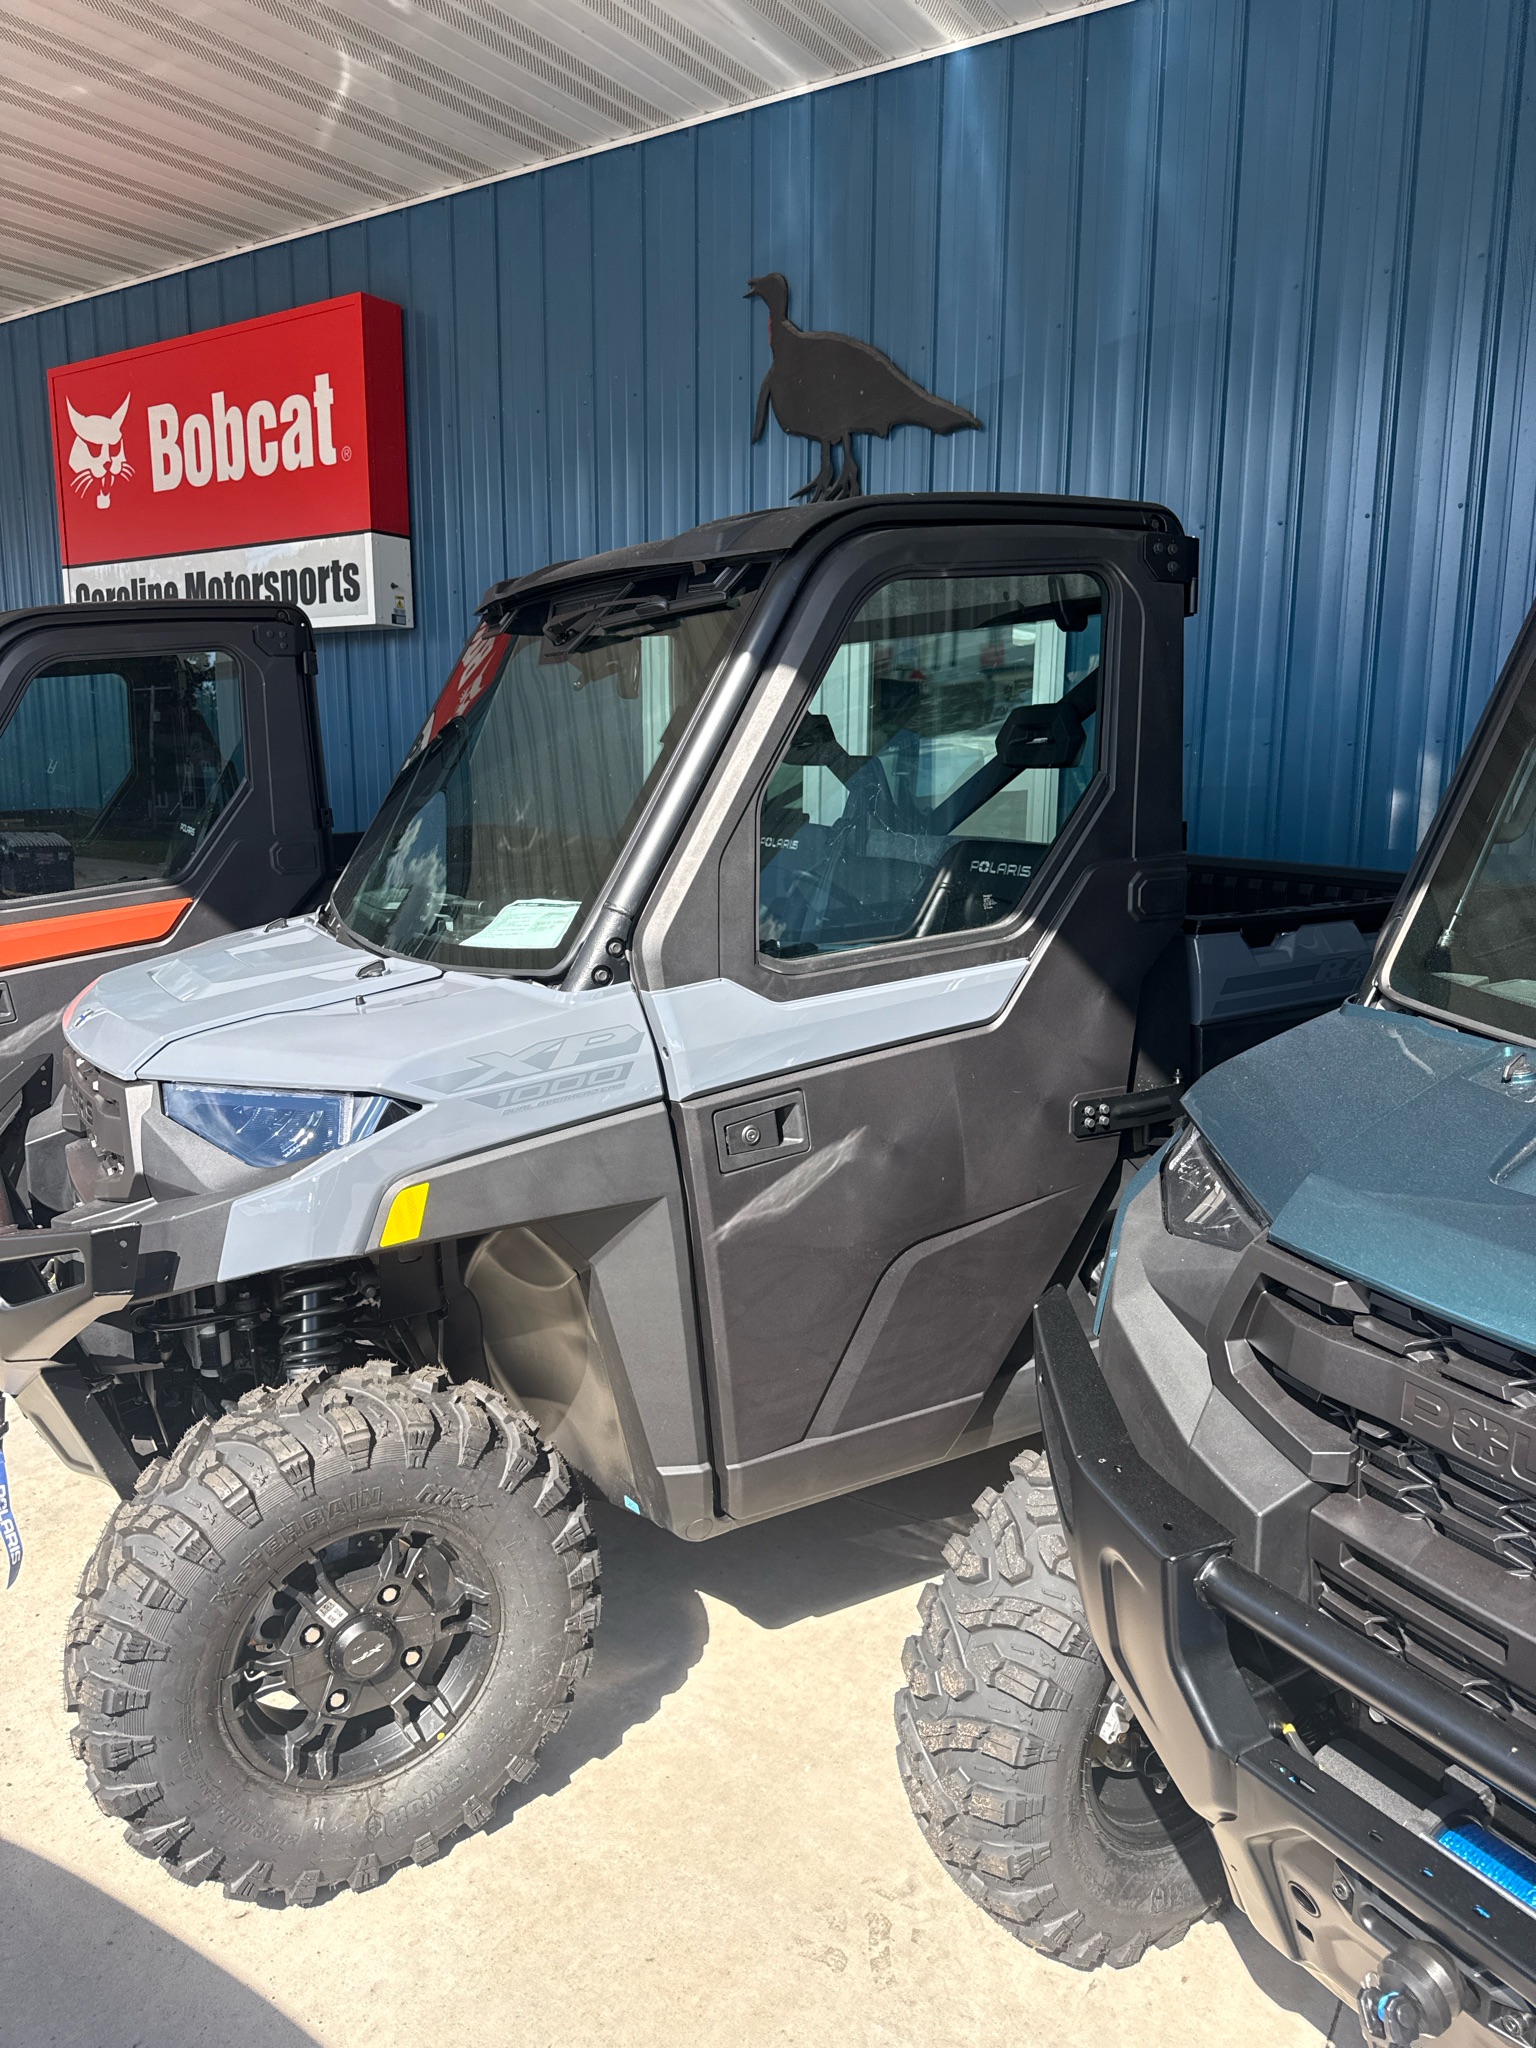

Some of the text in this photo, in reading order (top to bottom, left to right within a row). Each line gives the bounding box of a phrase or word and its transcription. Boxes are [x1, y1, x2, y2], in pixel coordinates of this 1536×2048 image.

[147, 373, 337, 493] Bobcat
[184, 559, 361, 607] Motorsports
[760, 836, 799, 850] POLARIS
[970, 860, 1032, 878] POLARIS
[453, 1024, 640, 1092] XP
[497, 1064, 625, 1107] 1000
